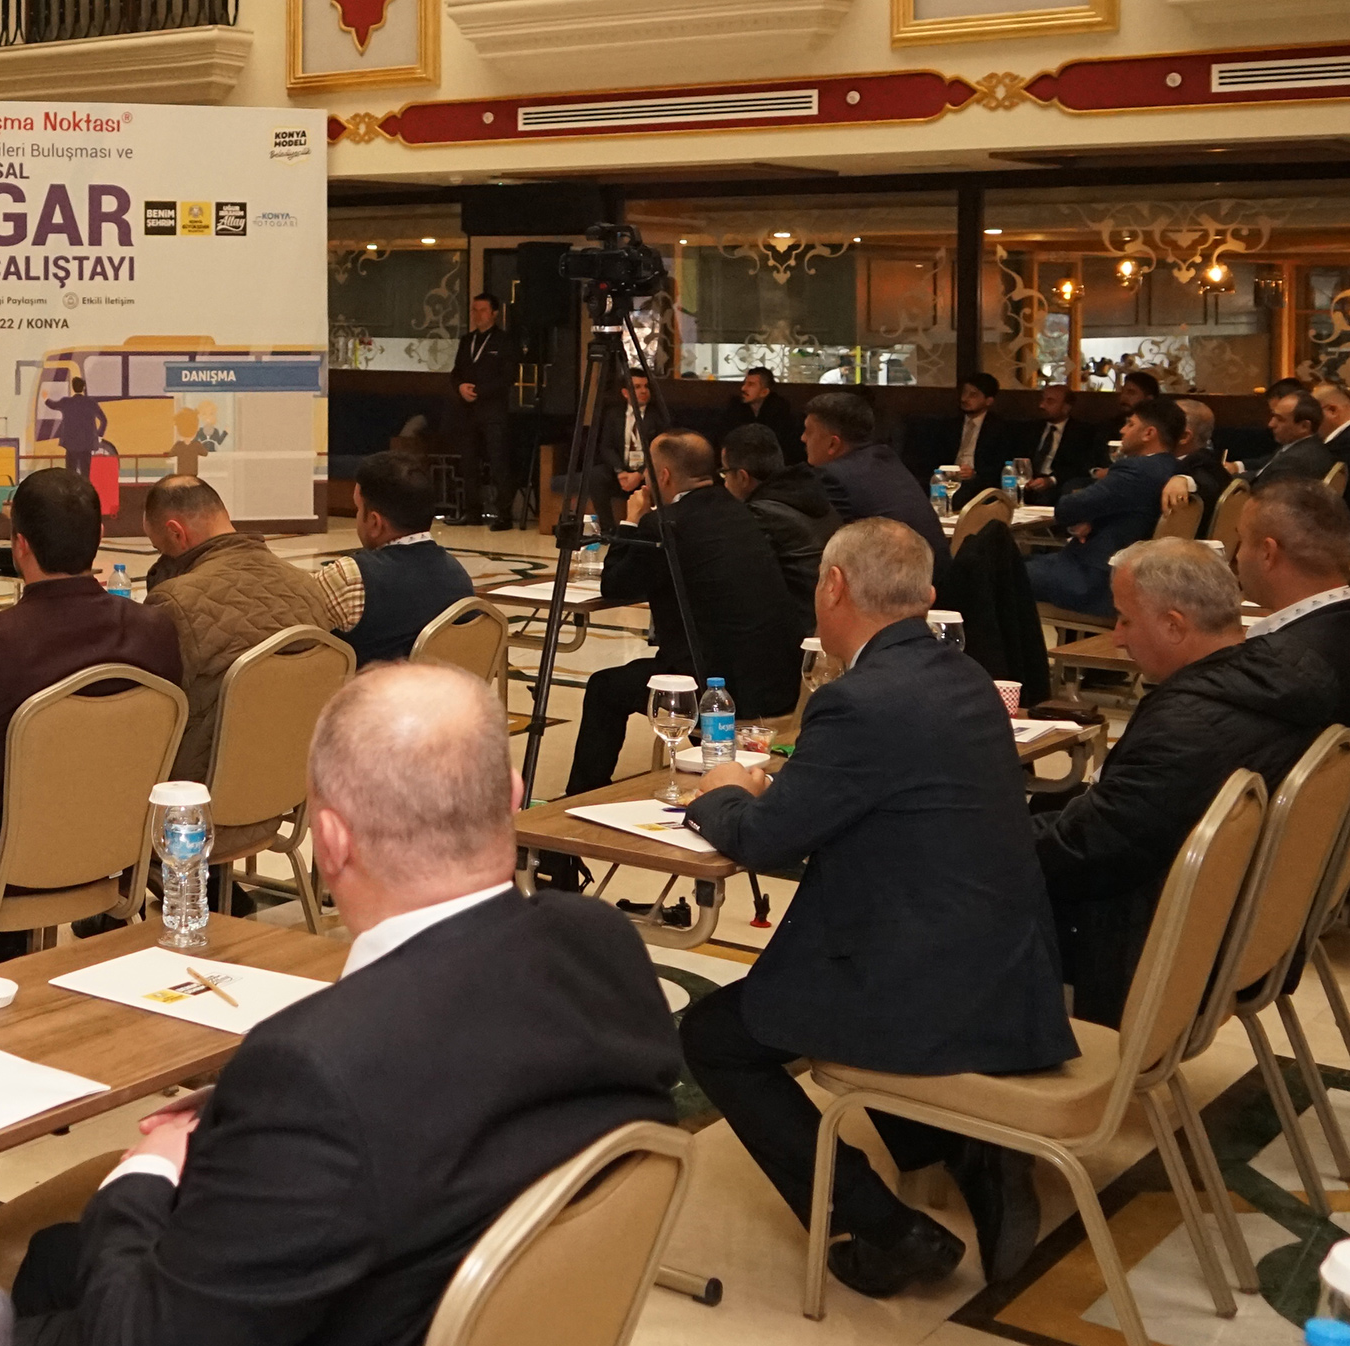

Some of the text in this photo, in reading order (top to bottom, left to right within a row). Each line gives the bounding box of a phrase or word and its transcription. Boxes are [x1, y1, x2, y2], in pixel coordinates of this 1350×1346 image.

[275, 130, 307, 139] KONYA
[30, 142, 112, 160] Buluşması
[117, 147, 133, 158] ve
[7, 296, 47, 306] Paylaşımı
[82, 295, 135, 306] Etkili İletişim
[26, 318, 70, 329] KONYA
[181, 370, 237, 385] DANIŞMA
